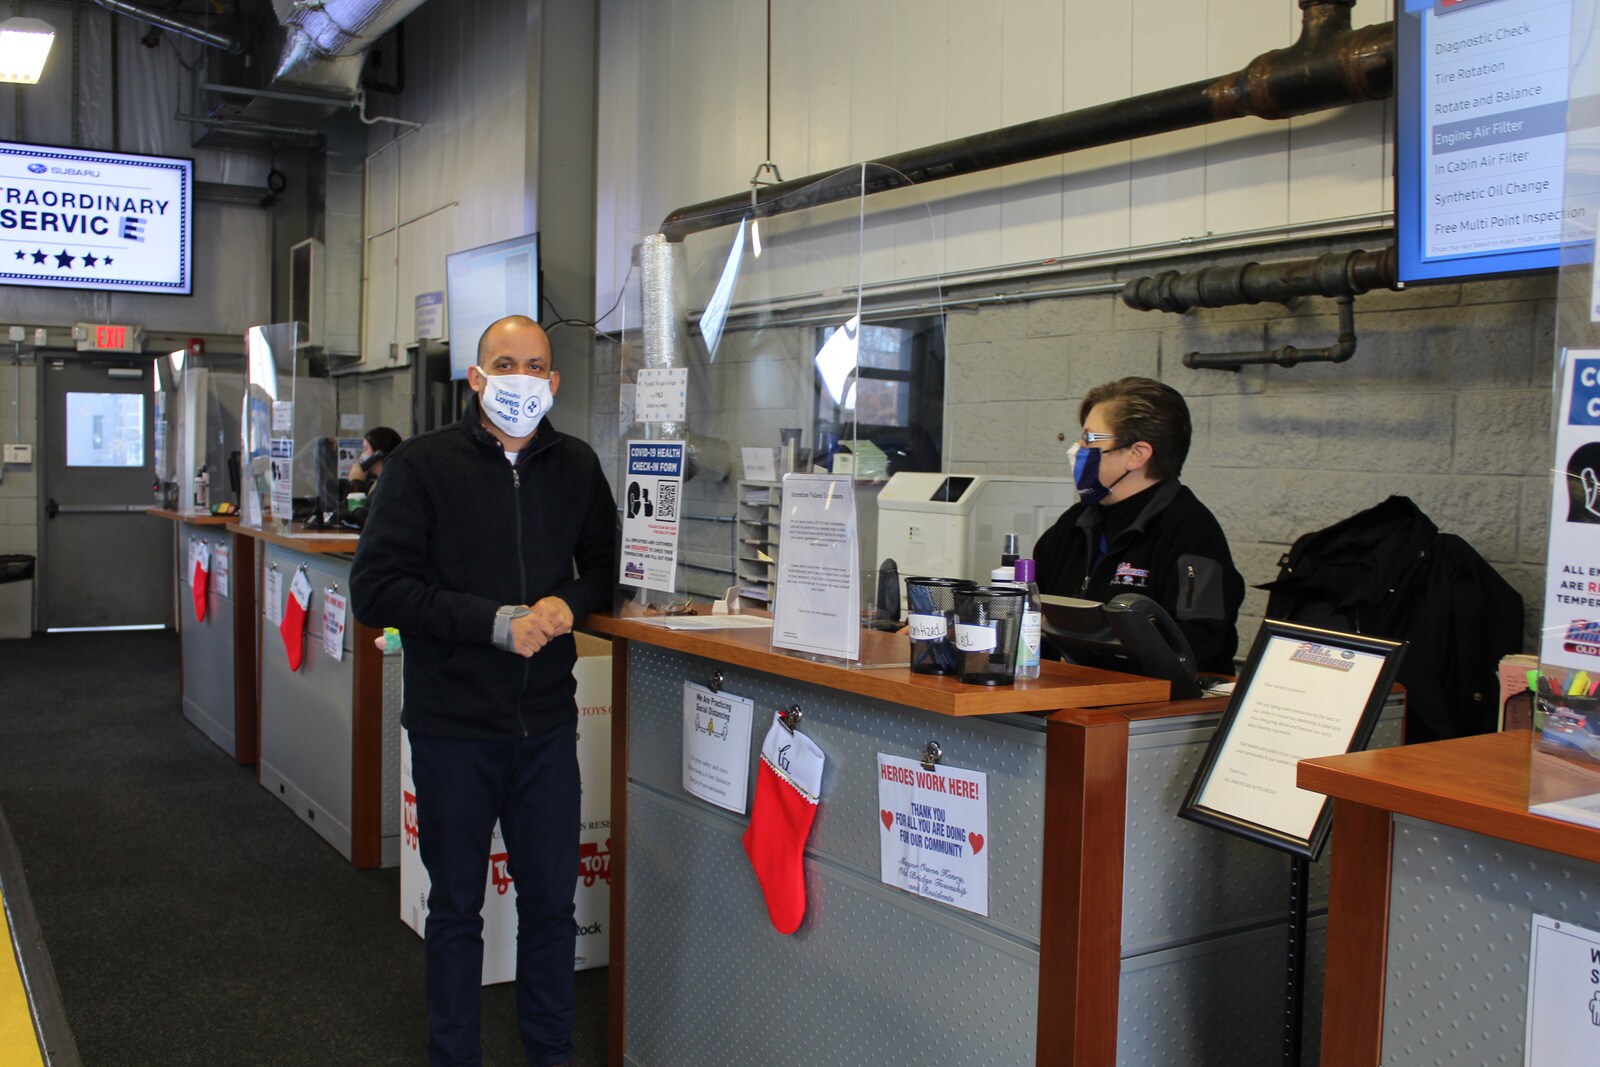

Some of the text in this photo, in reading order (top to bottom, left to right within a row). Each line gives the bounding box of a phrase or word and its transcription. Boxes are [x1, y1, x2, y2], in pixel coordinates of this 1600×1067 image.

[1434, 22, 1531, 55] Diagnostic Check
[1434, 61, 1506, 85] Tire Rotation
[1434, 84, 1543, 116] Rotate and Balance
[1434, 118, 1525, 146] Engine Air Filter
[50, 166, 101, 178] SUBARU
[1434, 149, 1530, 175] In Cabin Air Filter
[0, 186, 169, 216] RAORDINARY
[1434, 178, 1551, 207] Synthetic Oil Change
[1434, 205, 1586, 236] Free Multi Point Inspection
[96, 325, 127, 349] EXIT
[495, 393, 520, 408] Loves
[509, 407, 519, 416] to
[631, 448, 681, 458] COVID-19 HEALTH
[632, 461, 677, 472] CHECK-IN FORM
[1563, 564, 1585, 575] ALL
[1560, 580, 1584, 592] ARE
[582, 706, 607, 717] TOYS
[695, 702, 730, 723] Social Distancing
[697, 693, 702, 702] We
[710, 697, 731, 713] Practicing
[880, 762, 979, 800] HEROES WORK HERE!
[911, 802, 946, 823] THANK YOU
[895, 812, 966, 843] FOR ALL YOU ARE DOING
[899, 829, 963, 858] FOR OUR COMMUNITY
[898, 856, 965, 885] Mayor Owen Henry,
[898, 867, 968, 897] Old Bridge Township
[908, 884, 954, 903] and Residents
